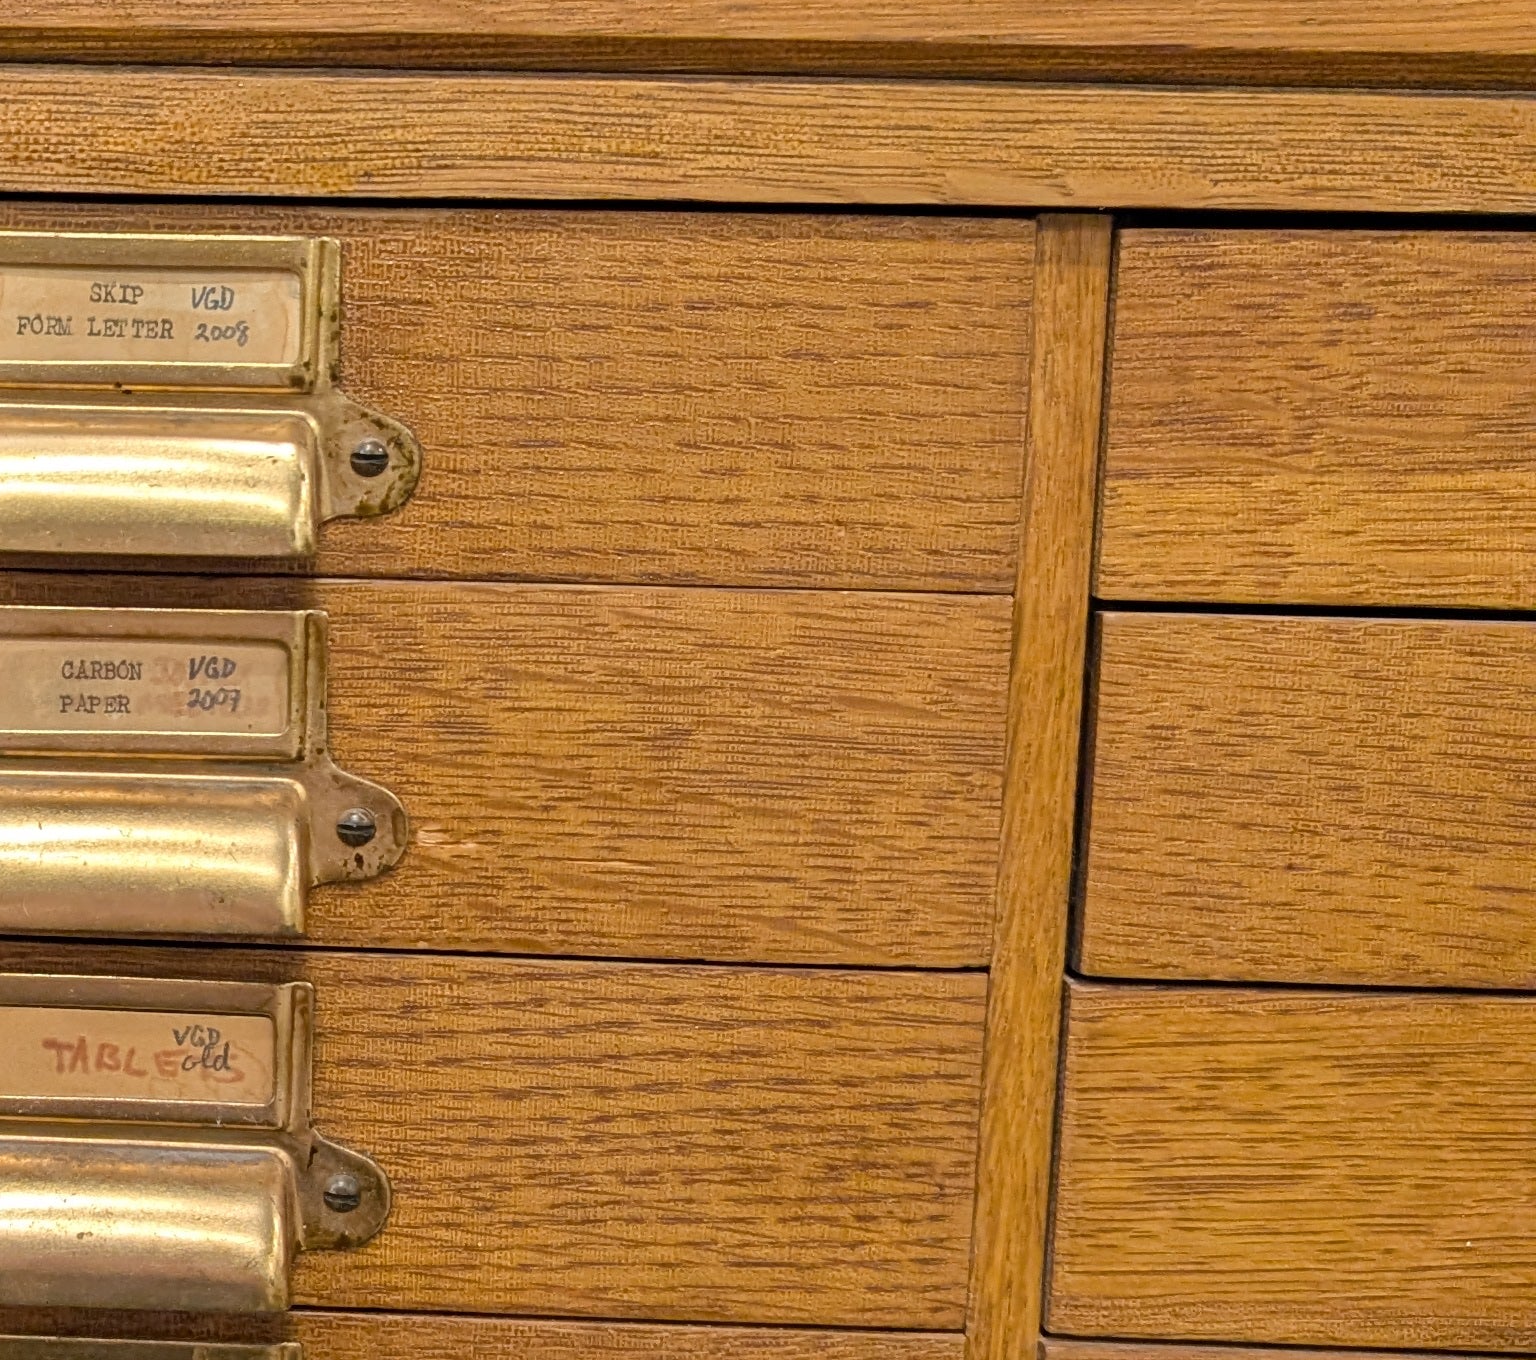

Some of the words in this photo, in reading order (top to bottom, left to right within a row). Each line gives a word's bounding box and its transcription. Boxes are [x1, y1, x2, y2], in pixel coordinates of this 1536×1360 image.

[89, 282, 144, 305] SKIP
[190, 286, 235, 311] VGD
[16, 314, 73, 337] FORM
[87, 317, 175, 340] LETTER
[194, 321, 251, 348] 2008
[61, 659, 143, 681] CARBON
[188, 655, 238, 680] VGD
[59, 694, 131, 714] PAPER
[172, 1024, 222, 1048] VGD
[181, 1042, 232, 1072] old
